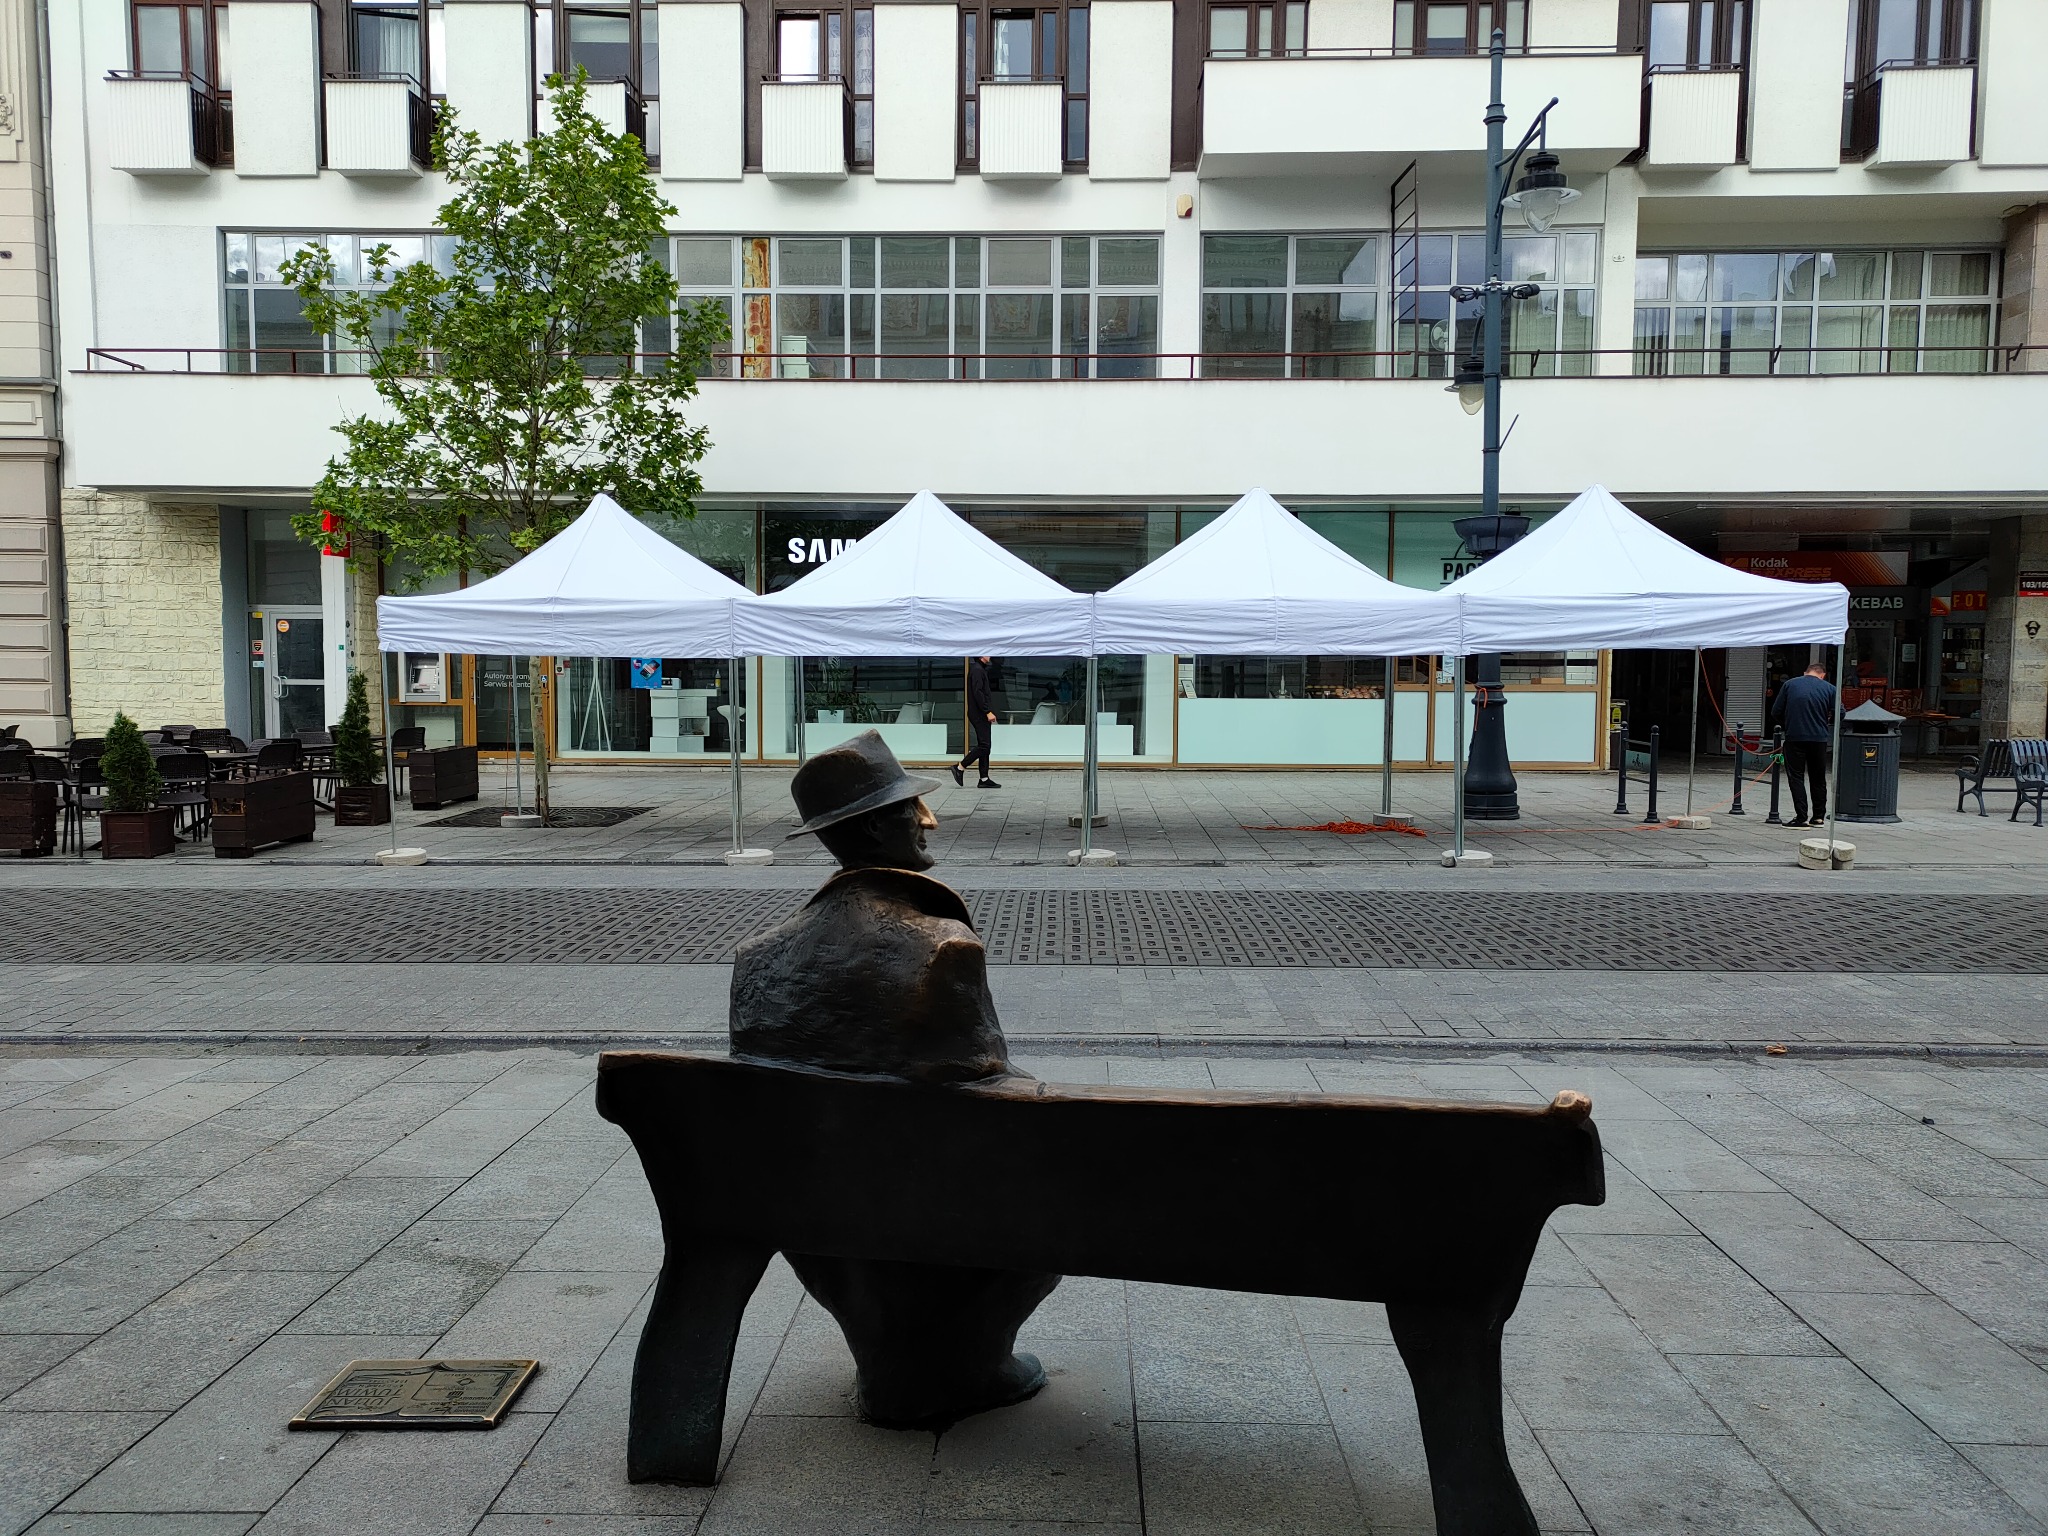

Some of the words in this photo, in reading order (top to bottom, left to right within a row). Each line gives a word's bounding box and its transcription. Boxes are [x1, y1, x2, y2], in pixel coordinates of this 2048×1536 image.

[1750, 557, 1789, 568] Kodak
[1849, 596, 1904, 609] KEBAB
[483, 672, 531, 680] Autoryzoany
[338, 1388, 402, 1396] TUWIM
[325, 1396, 401, 1406] JULIAN
